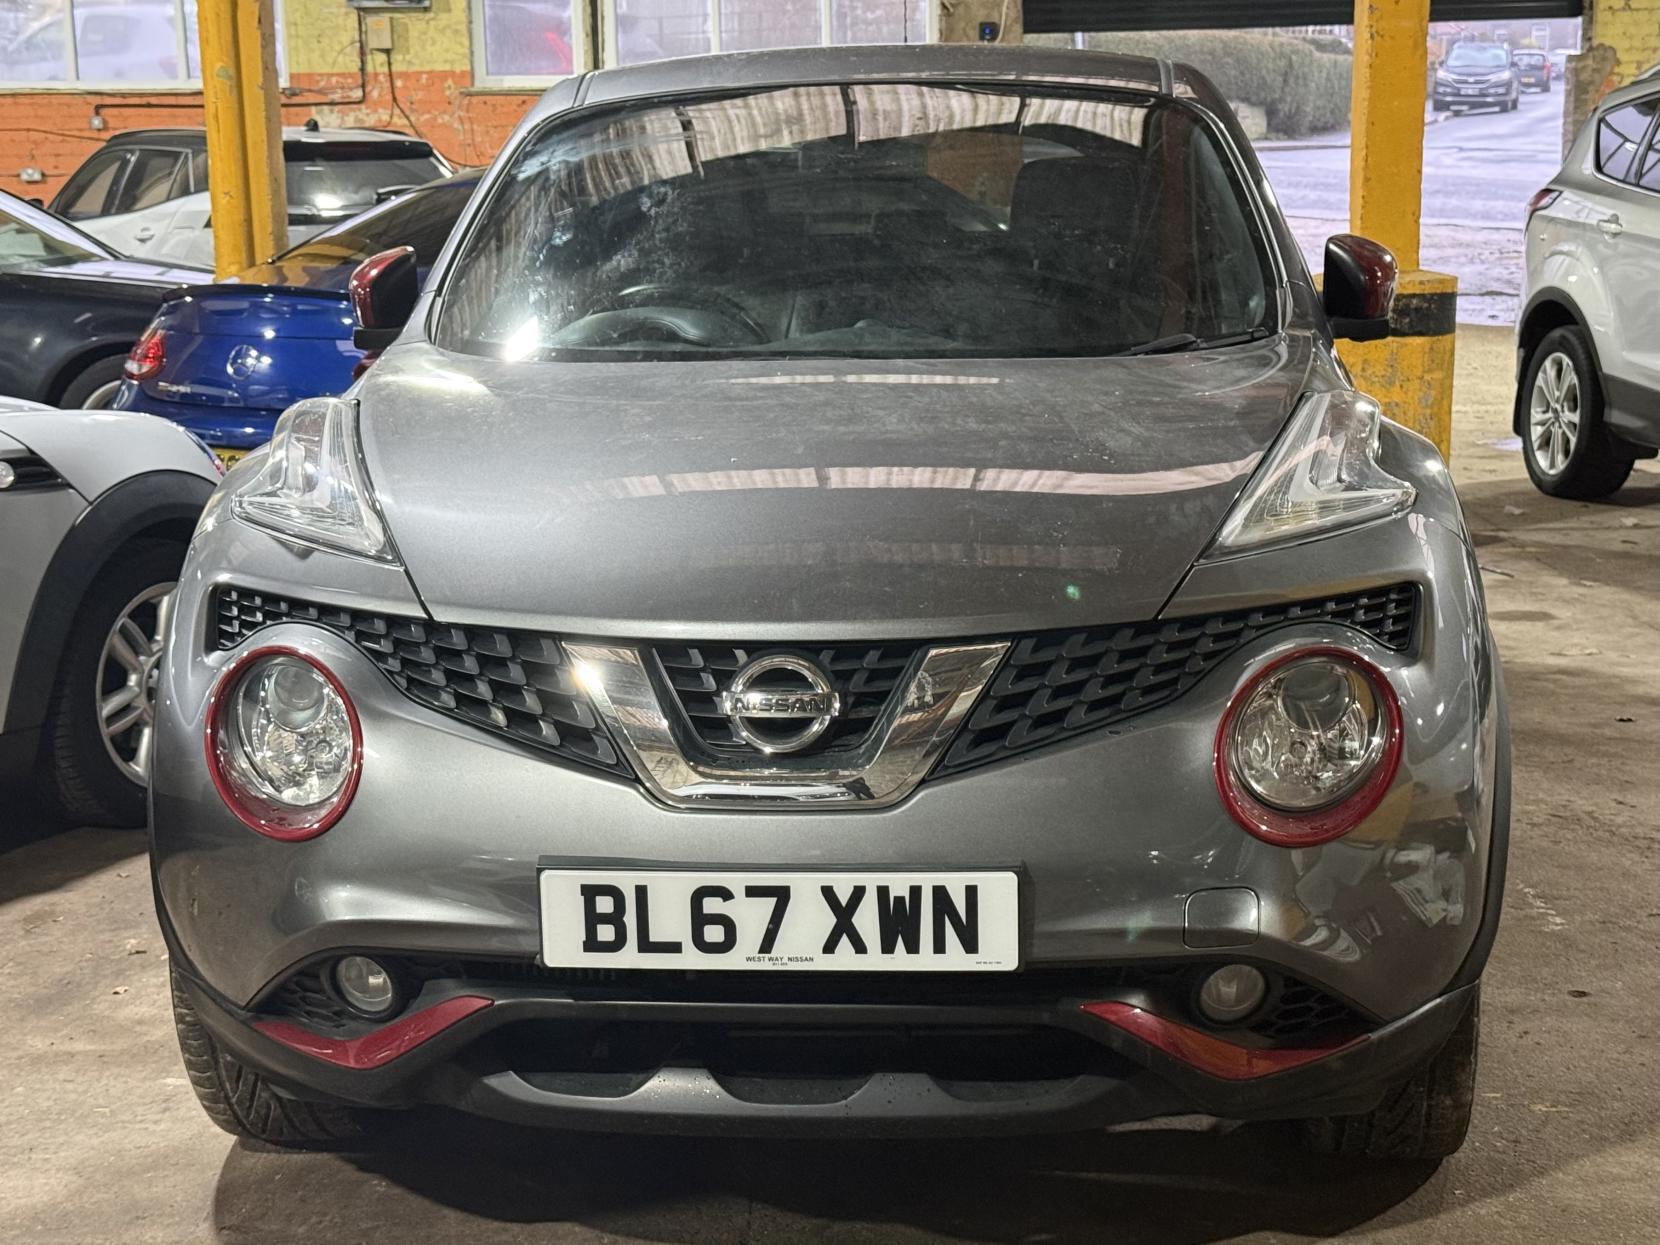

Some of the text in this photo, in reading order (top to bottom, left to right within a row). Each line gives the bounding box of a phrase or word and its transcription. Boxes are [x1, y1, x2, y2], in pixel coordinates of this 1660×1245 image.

[734, 697, 827, 714] NISSAN
[580, 884, 979, 954] BL67 XWN
